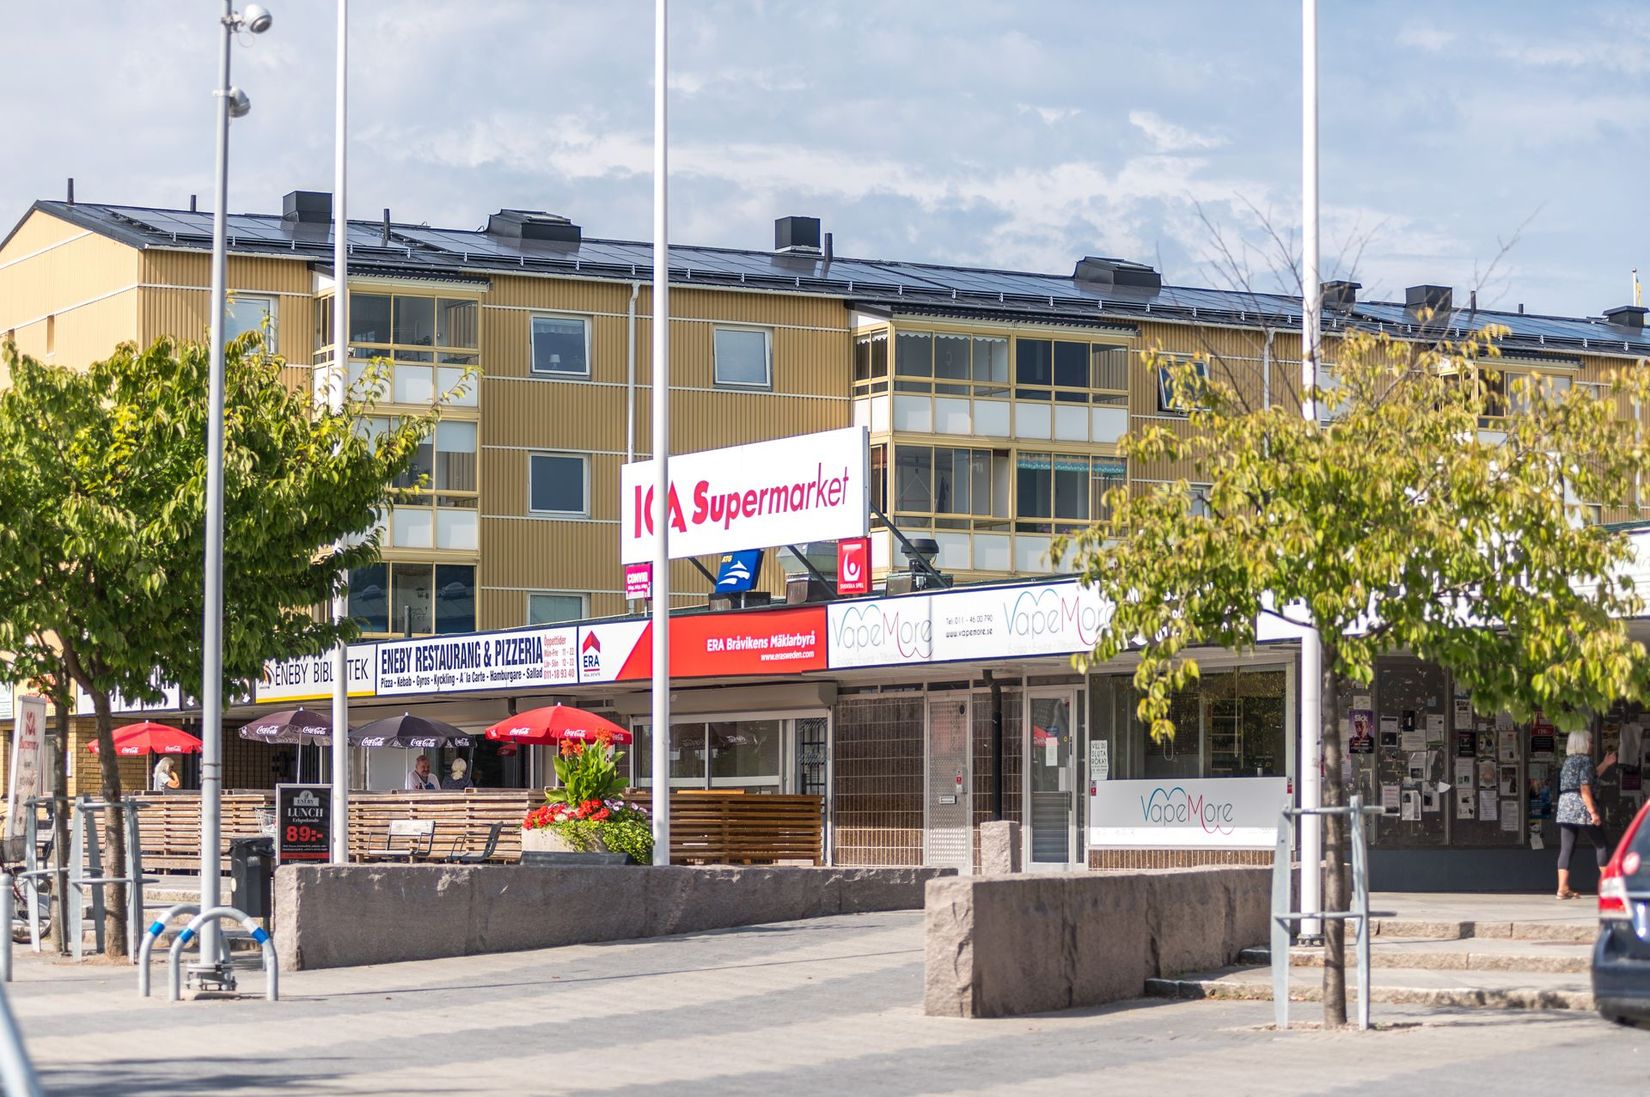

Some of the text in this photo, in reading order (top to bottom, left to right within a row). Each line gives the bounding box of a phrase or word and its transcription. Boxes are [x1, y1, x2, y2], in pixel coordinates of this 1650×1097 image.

[692, 462, 849, 530] Supermarket
[706, 630, 816, 652] ERA Bråvikens Mäklarbyrå
[832, 604, 934, 659] VapeMore
[381, 636, 543, 674] ENEBY RESTAURANG & PIZZERIA
[583, 655, 600, 668] ERA
[760, 650, 815, 661] www.erasweden.com
[275, 658, 369, 686] ENEBY BIBLTEK
[380, 677, 393, 688] Pizza
[397, 676, 412, 686] Kebab
[416, 675, 430, 688] Gyros
[433, 673, 455, 687] Kyckling
[472, 671, 486, 682] Carte
[490, 669, 522, 682] Hamburgare
[526, 668, 543, 679] Sallad
[287, 807, 323, 817] LUNCH
[1140, 787, 1236, 835] VapeMore
[286, 825, 323, 842] 89:-
